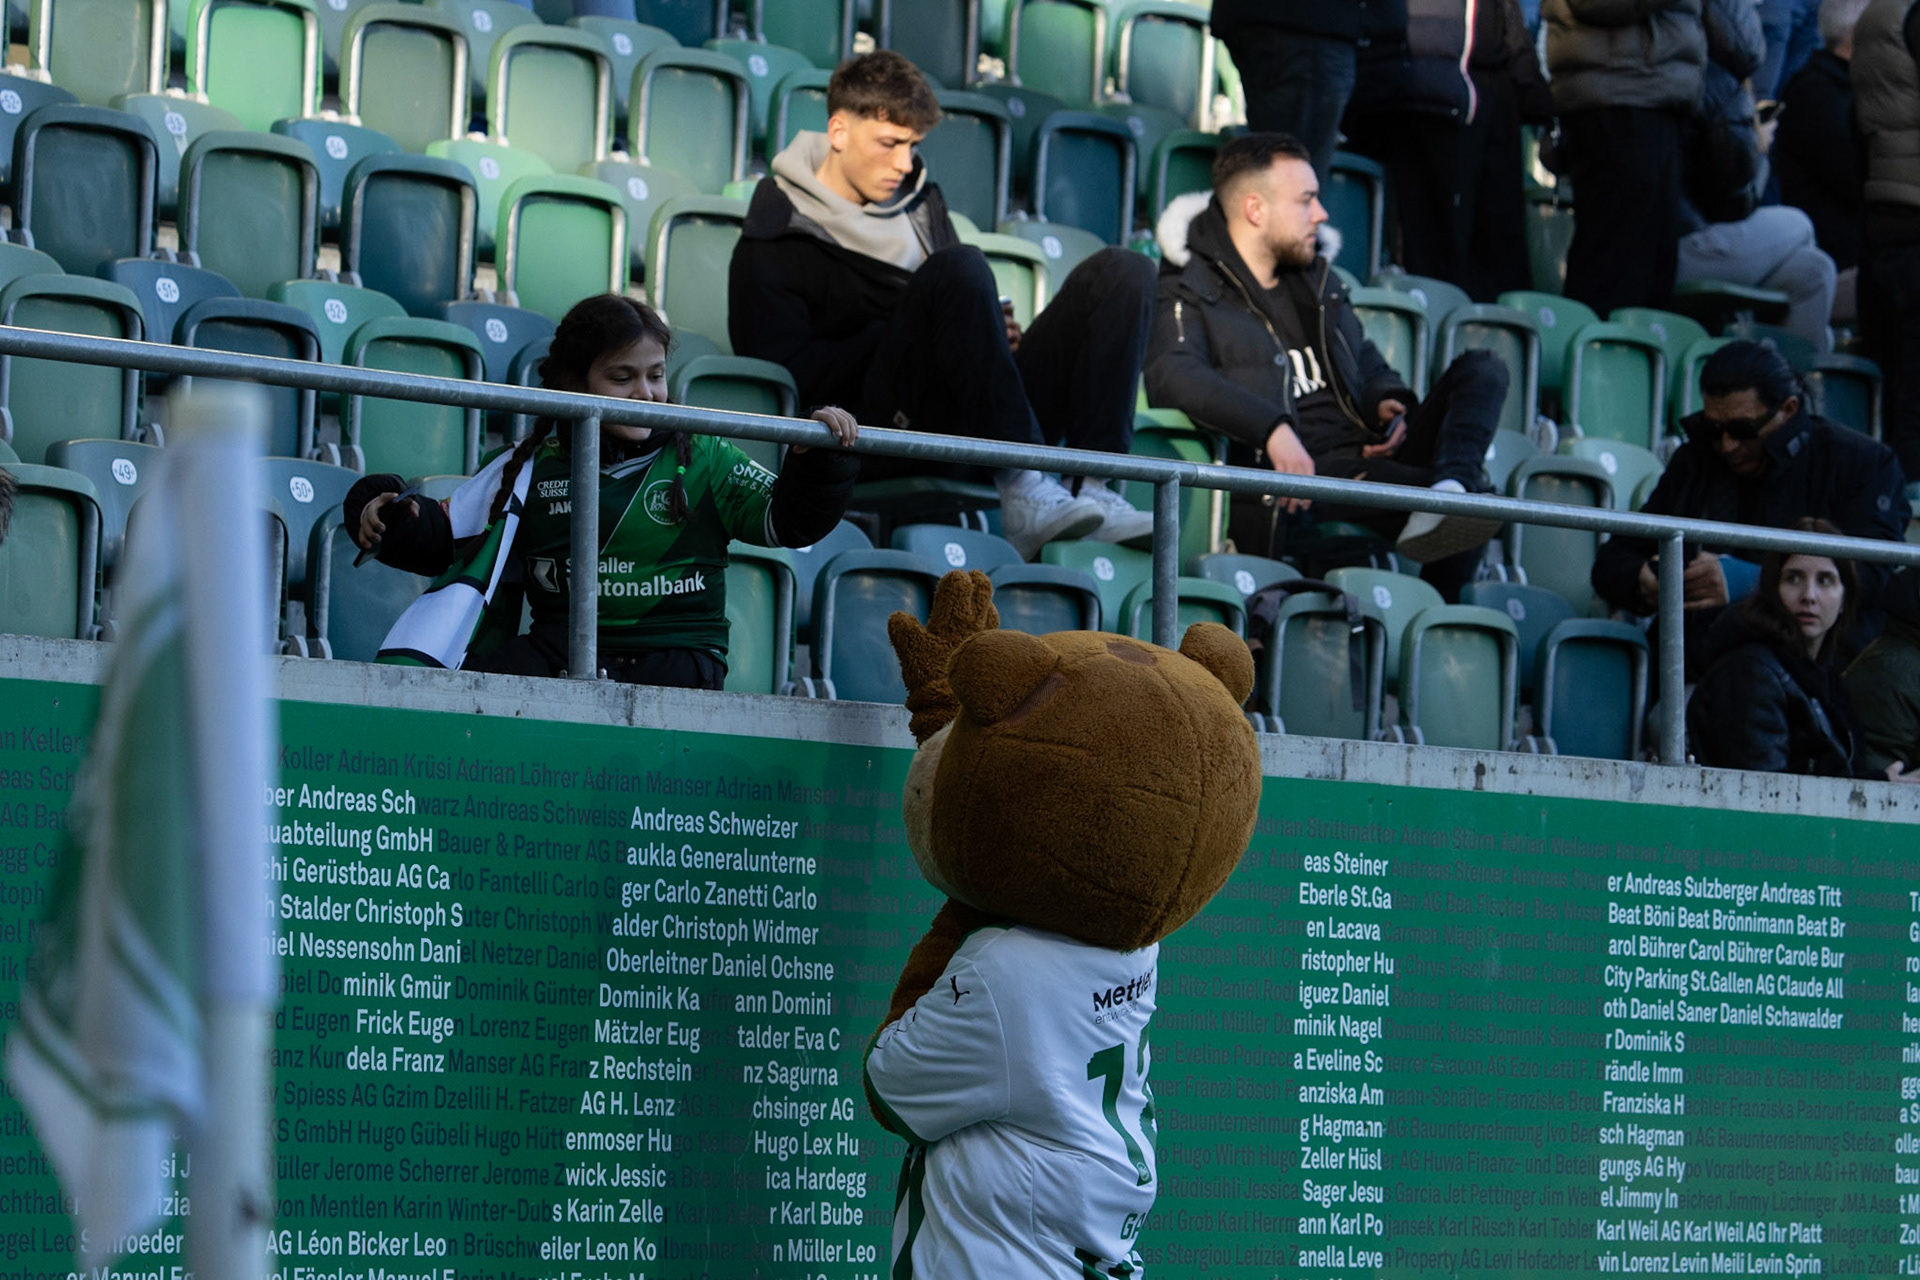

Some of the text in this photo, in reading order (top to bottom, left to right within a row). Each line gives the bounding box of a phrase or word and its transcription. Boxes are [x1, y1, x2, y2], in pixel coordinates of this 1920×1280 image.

[161, 280, 174, 300] 51
[117, 461, 132, 480] 49
[294, 479, 308, 498] 50
[537, 480, 570, 491] CREDIT
[540, 488, 568, 498] SUISSE
[337, 750, 398, 777] Adrian
[404, 754, 451, 781] Krüsi
[456, 758, 515, 785] Adrian
[521, 762, 578, 789] Löhrer
[298, 784, 376, 812] Andreas
[464, 793, 538, 822] Andreas
[543, 799, 627, 830] Schweiss
[630, 807, 704, 834] Andreas
[708, 811, 798, 840] Schweizer
[376, 826, 433, 852] GmbH
[438, 830, 490, 856] Bauer
[515, 834, 581, 861] Partner
[586, 838, 610, 863] AG
[293, 859, 391, 888] Gerüstbau
[396, 864, 422, 889] AG
[553, 873, 598, 899] Carlo
[655, 879, 700, 905] Carlo
[704, 881, 768, 908] Zanetti
[772, 885, 817, 911] Carlo
[1334, 851, 1389, 877] Steiner
[1625, 870, 1682, 895] Andreas
[1684, 872, 1758, 906] Sulzberger
[1760, 877, 1815, 904] Andreas
[280, 895, 350, 922] Stalder
[355, 898, 446, 932] Christoph
[663, 915, 748, 948] Christoph
[753, 919, 819, 946] Widmer
[1300, 881, 1347, 907] Eberle
[1609, 900, 1640, 925] Beat
[1644, 902, 1675, 927] Böni
[1678, 904, 1709, 929] Beat
[1713, 906, 1794, 935] Brönnimann
[1798, 911, 1828, 937] Beat
[301, 933, 766, 978] Nessensohn Netzer Daniel Oberleitner Daniel
[1329, 915, 1380, 942] Lacava
[1640, 933, 1686, 960] Bührer
[1689, 936, 1725, 962] Carol
[1728, 939, 1772, 965] Bührer
[1776, 942, 1818, 968] Carole
[401, 974, 672, 1010] Gmür Dominik Günter Dominik
[1604, 963, 1822, 999] City Parking St.Gallen AG Claude
[1342, 981, 1842, 1029] Daniel Daniel Saner Daniel Schawalder
[292, 1007, 824, 1051] Eugen Frick Lorenz Eugen Mätzler Eva
[1340, 1013, 1382, 1045] Nagel
[1615, 1025, 1672, 1052] Dominik
[392, 1048, 838, 1091] Franz Manser AG Sagurna
[1307, 1046, 1361, 1072] Eveline
[351, 1085, 376, 1109] AG
[520, 1089, 575, 1115] Fatzer
[580, 1091, 605, 1115] AG
[610, 1092, 628, 1116] H.
[634, 1092, 674, 1117] Lenz
[830, 1097, 854, 1121] AG
[1603, 1088, 1670, 1115] Franziska
[358, 1121, 404, 1152] Hugo
[411, 1122, 469, 1148] Gübeli
[476, 1125, 520, 1156] Hugo
[755, 1131, 798, 1161] Hugo
[804, 1132, 832, 1156] Lex
[1313, 1112, 1383, 1143] Hagmann
[324, 1157, 549, 1186] Jerome Scherrer Jerome
[1301, 1146, 1344, 1170] Zeller
[1644, 1153, 1664, 1177] AG
[311, 1195, 816, 1226] Mentlen Karin Karin Karl
[1303, 1178, 1346, 1209] Sager
[1616, 1184, 1662, 1216] Jimmy
[1330, 1212, 1788, 1243] Karl Karl Weil AG Karl Weil AG Ihr
[266, 1231, 842, 1263] AG Léon Bicker Leon Müller
[1622, 1249, 1783, 1274] Lorenz Levin Meili Levin
